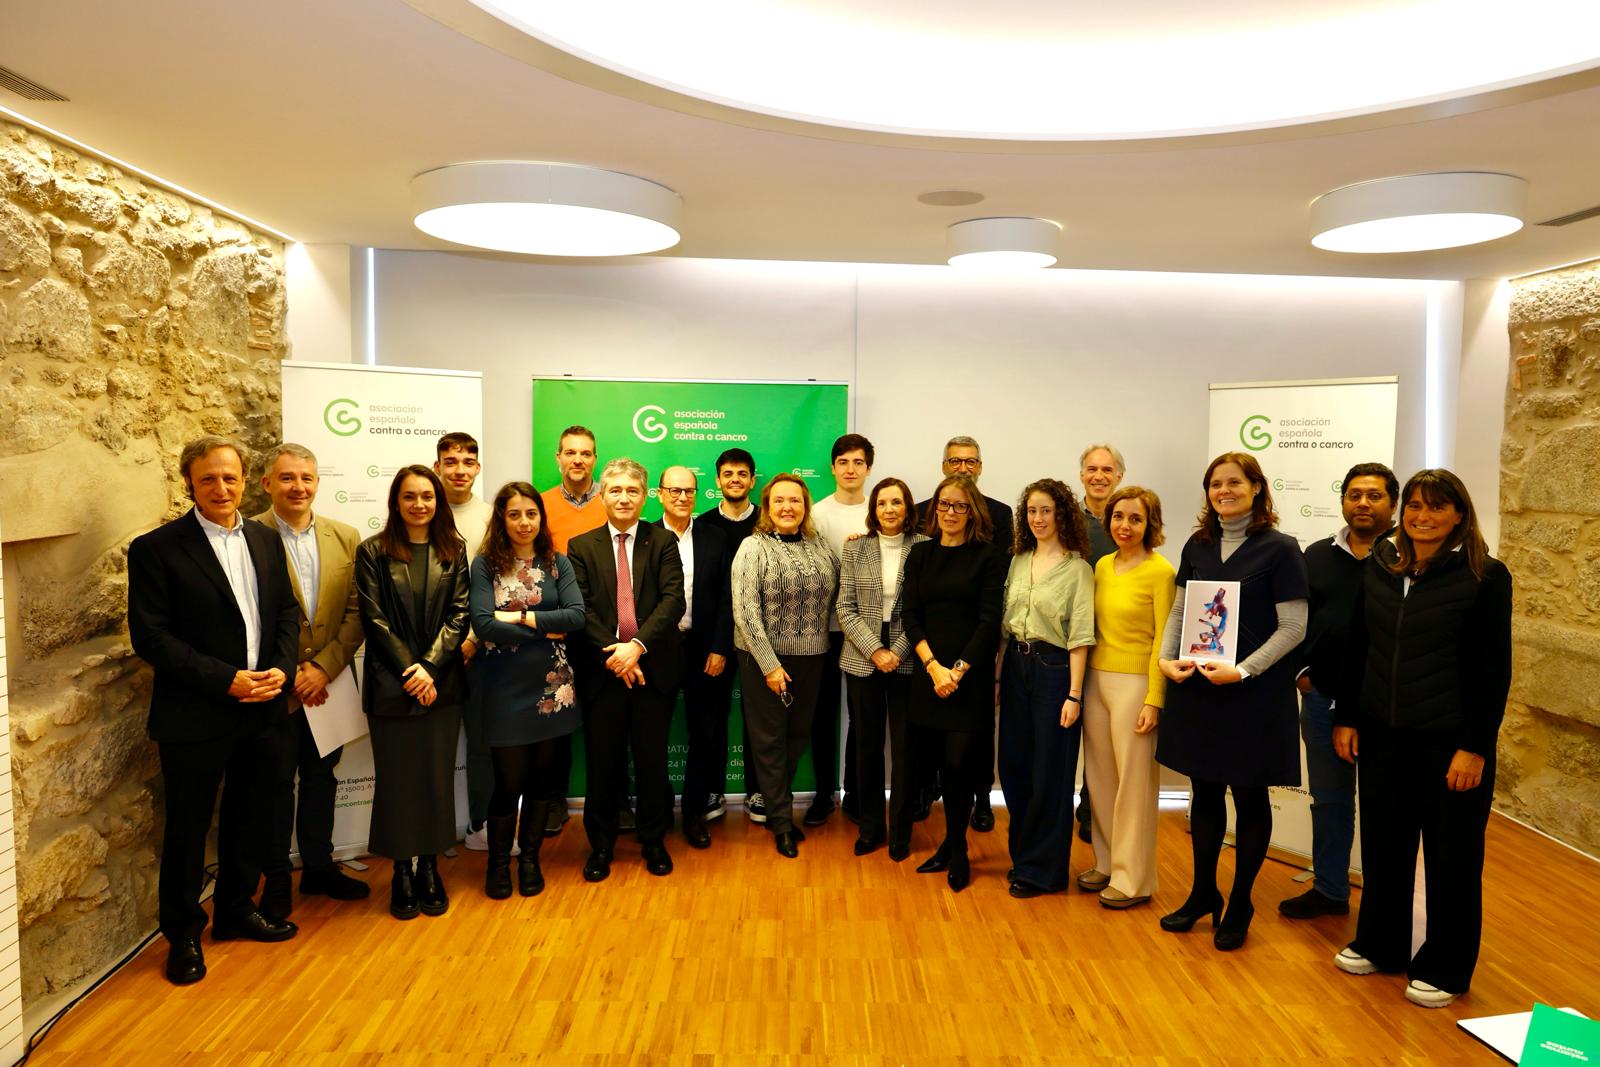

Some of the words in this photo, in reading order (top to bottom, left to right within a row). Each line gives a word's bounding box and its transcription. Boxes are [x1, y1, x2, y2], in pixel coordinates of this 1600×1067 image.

[369, 404, 423, 414] asociación
[674, 409, 725, 419] asociación
[369, 415, 416, 426] española
[674, 420, 718, 431] española
[1280, 417, 1331, 427] asociación
[369, 426, 403, 435] contra
[405, 428, 411, 436] o
[414, 428, 448, 436] cancro
[1279, 428, 1323, 439] española
[674, 431, 706, 441] contra
[715, 434, 748, 442] cancro
[1278, 440, 1309, 449] contra
[1320, 441, 1354, 449] cancro
